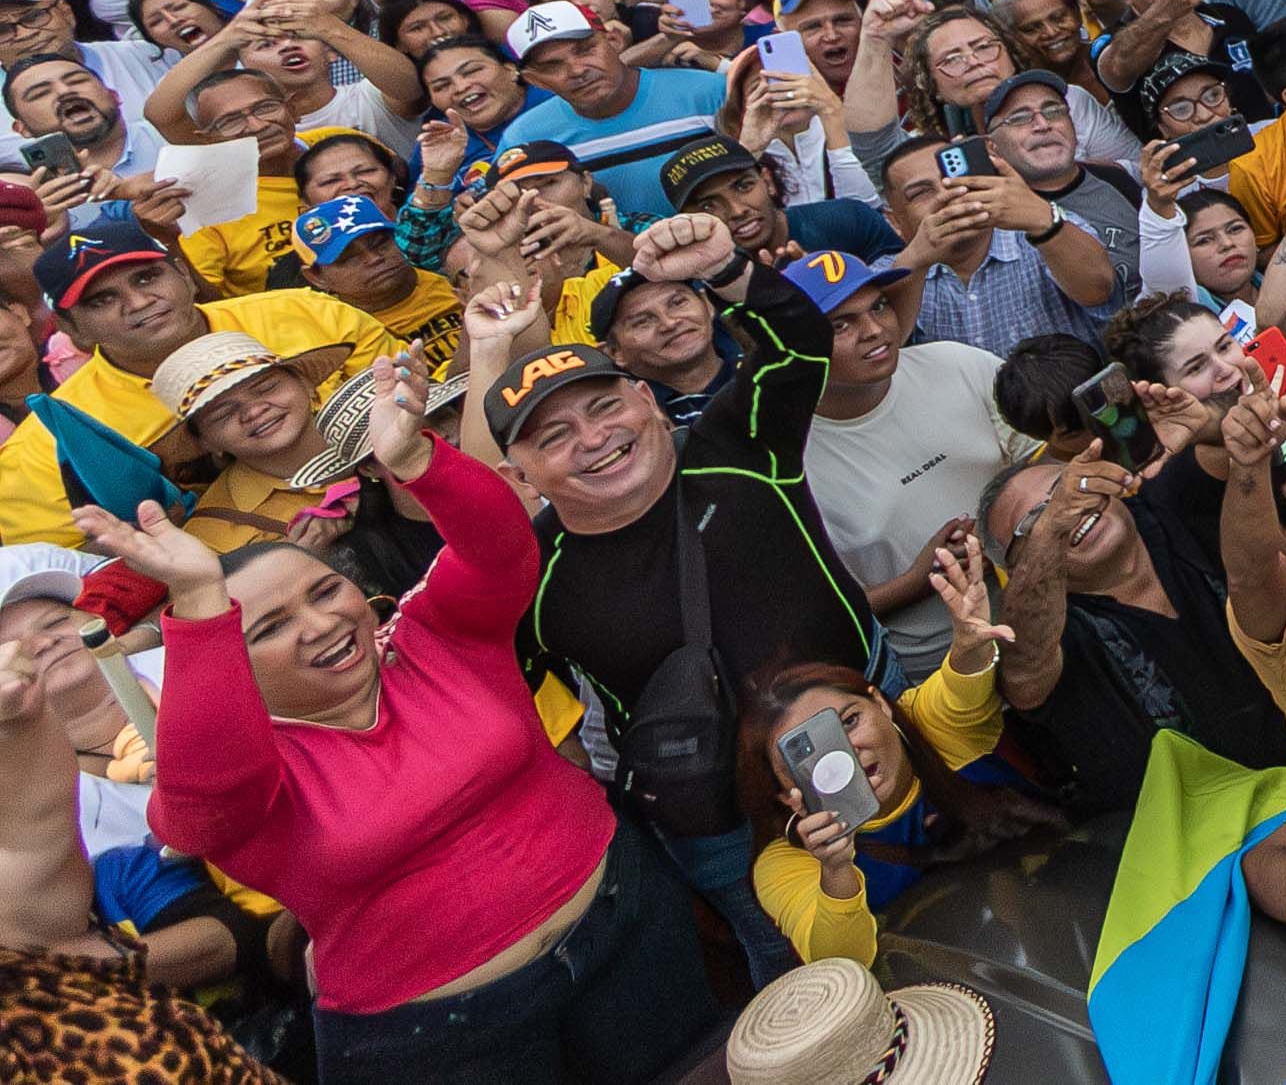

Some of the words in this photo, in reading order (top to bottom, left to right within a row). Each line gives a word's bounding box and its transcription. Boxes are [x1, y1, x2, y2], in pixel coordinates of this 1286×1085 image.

[501, 350, 586, 407] LAG
[900, 467, 925, 487] REAL
[922, 453, 947, 472] DEAL
